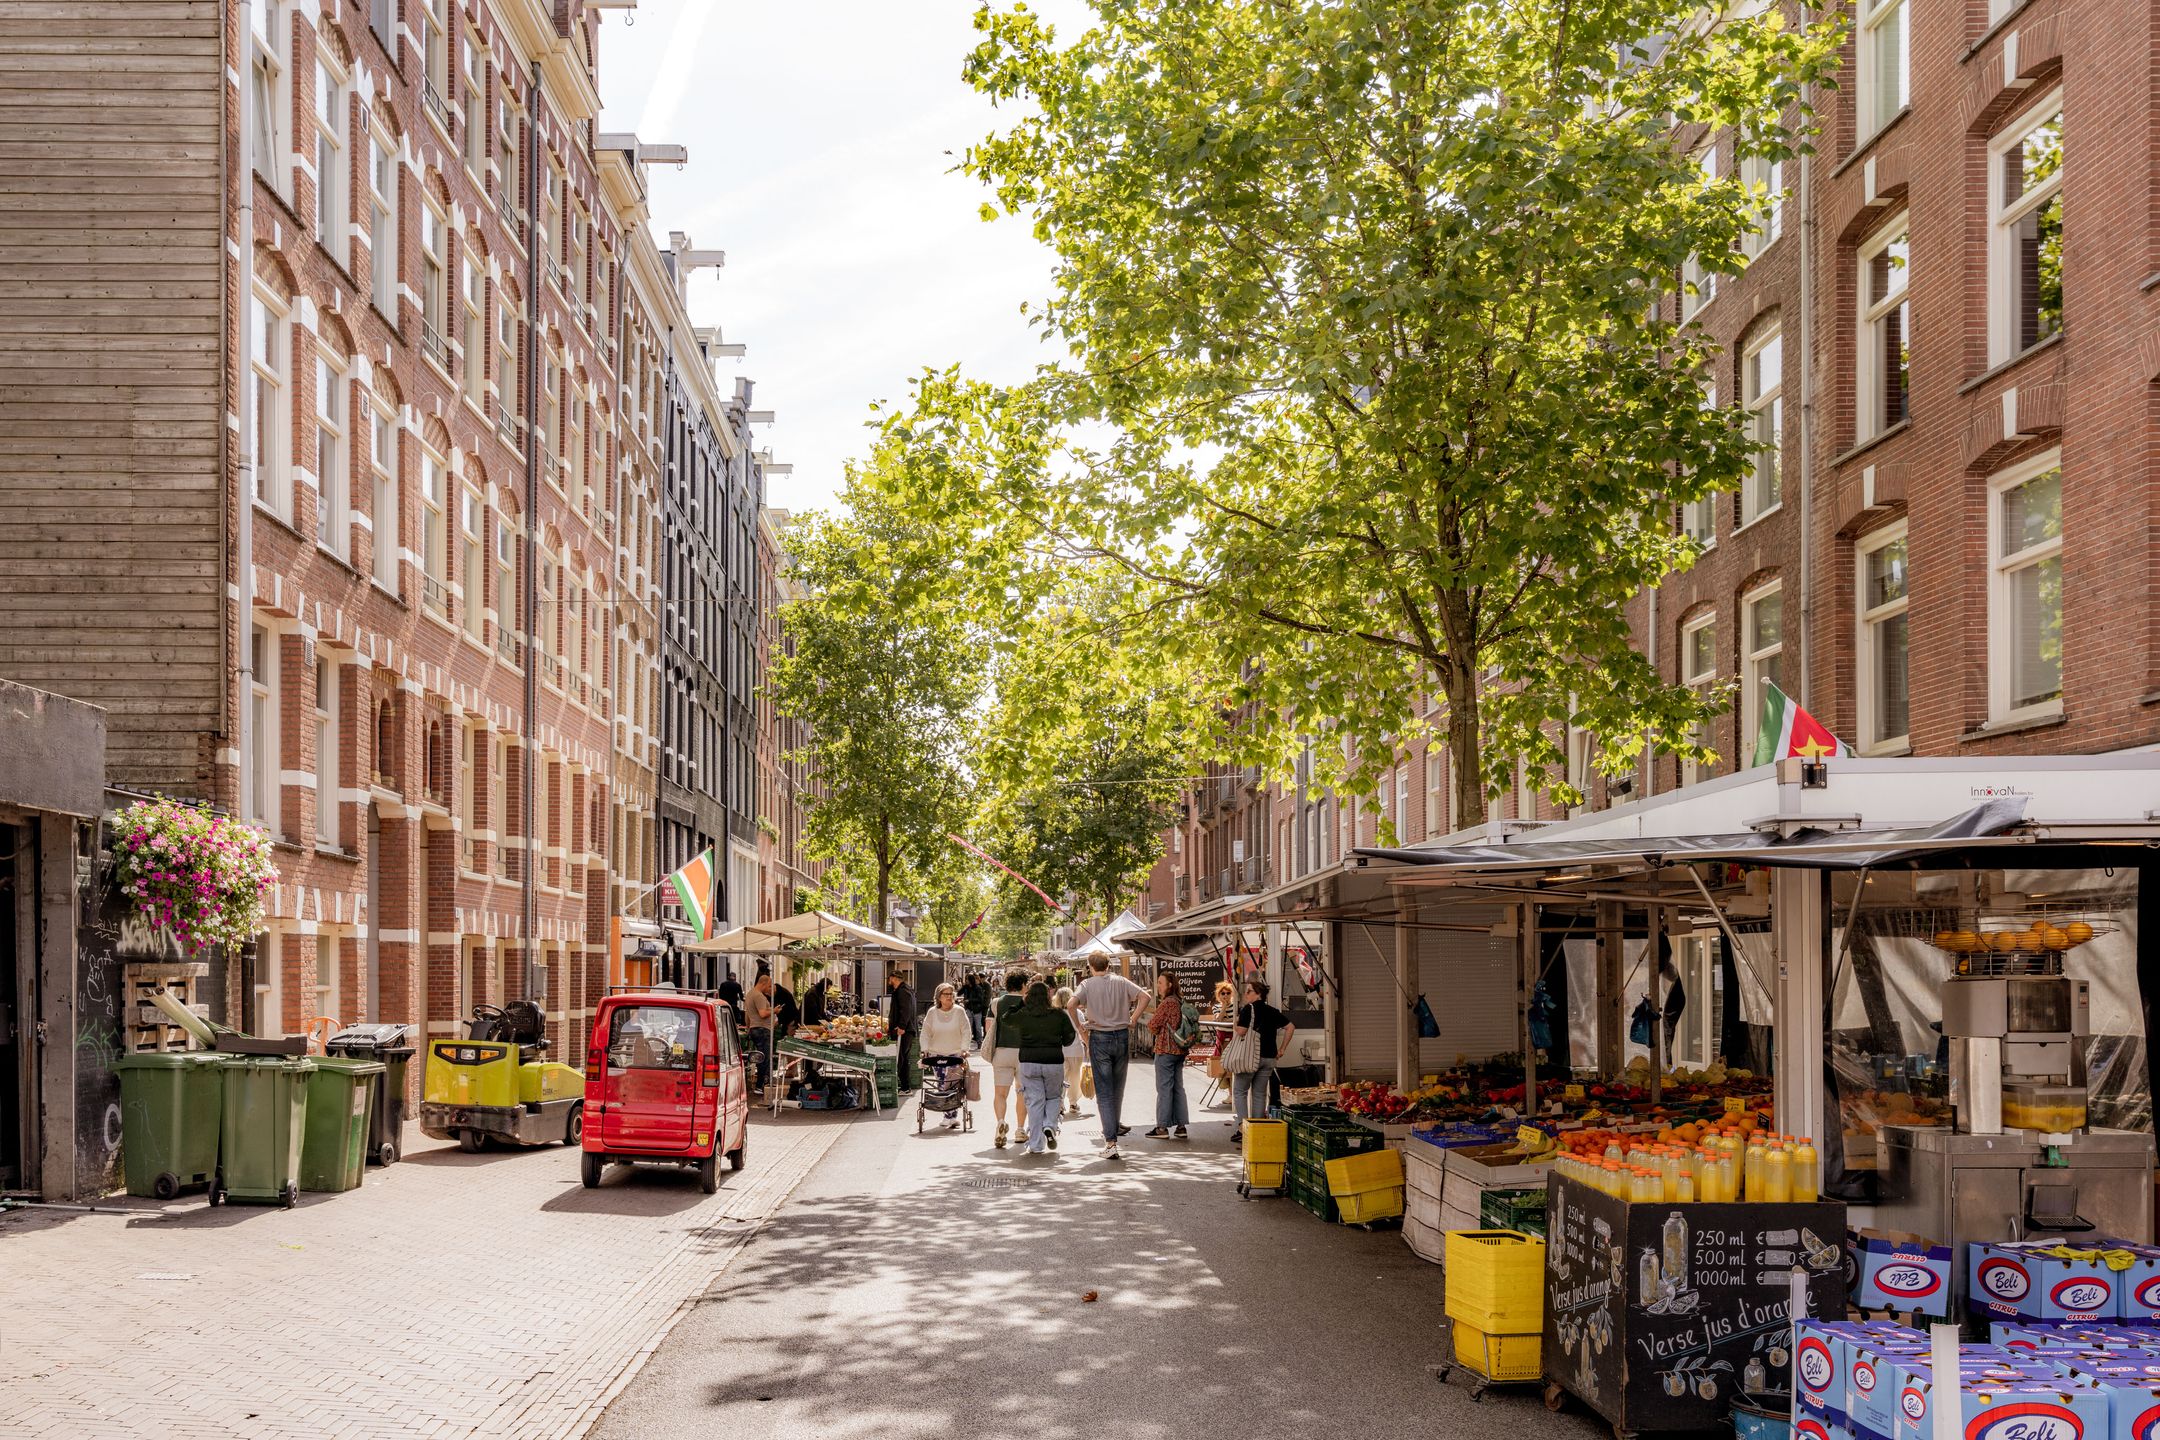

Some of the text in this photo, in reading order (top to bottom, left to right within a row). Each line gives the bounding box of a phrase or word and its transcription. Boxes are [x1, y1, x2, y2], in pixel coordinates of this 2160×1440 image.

[1160, 959, 1220, 969] Delicatessen
[1178, 978, 1203, 986] Olijven
[1567, 1204, 1579, 1222] 250
[1566, 1223, 1578, 1240] 500
[1695, 1230, 1725, 1246] 250
[1728, 1230, 1746, 1246] ml
[1566, 1241, 1579, 1260] 1000
[1694, 1250, 1725, 1266] 500
[1728, 1250, 1747, 1266] ml
[1891, 1253, 1926, 1263] CITRUS
[1889, 1271, 1920, 1287] Beli
[1994, 1271, 2019, 1290] Beli
[1549, 1281, 1571, 1312] Verse
[1572, 1281, 1584, 1315] jus
[2070, 1287, 2099, 1304] Beli
[1988, 1301, 2018, 1316] CITRUS
[2066, 1313, 2098, 1321] CITRUS
[1637, 1290, 1818, 1361] Verse jus d'orane
[1805, 1353, 1824, 1377] Beli
[1859, 1370, 1871, 1383] Beli
[1804, 1391, 1824, 1408] CITRUS
[1907, 1397, 1920, 1411] Beli
[1903, 1417, 1919, 1430] CITRUS
